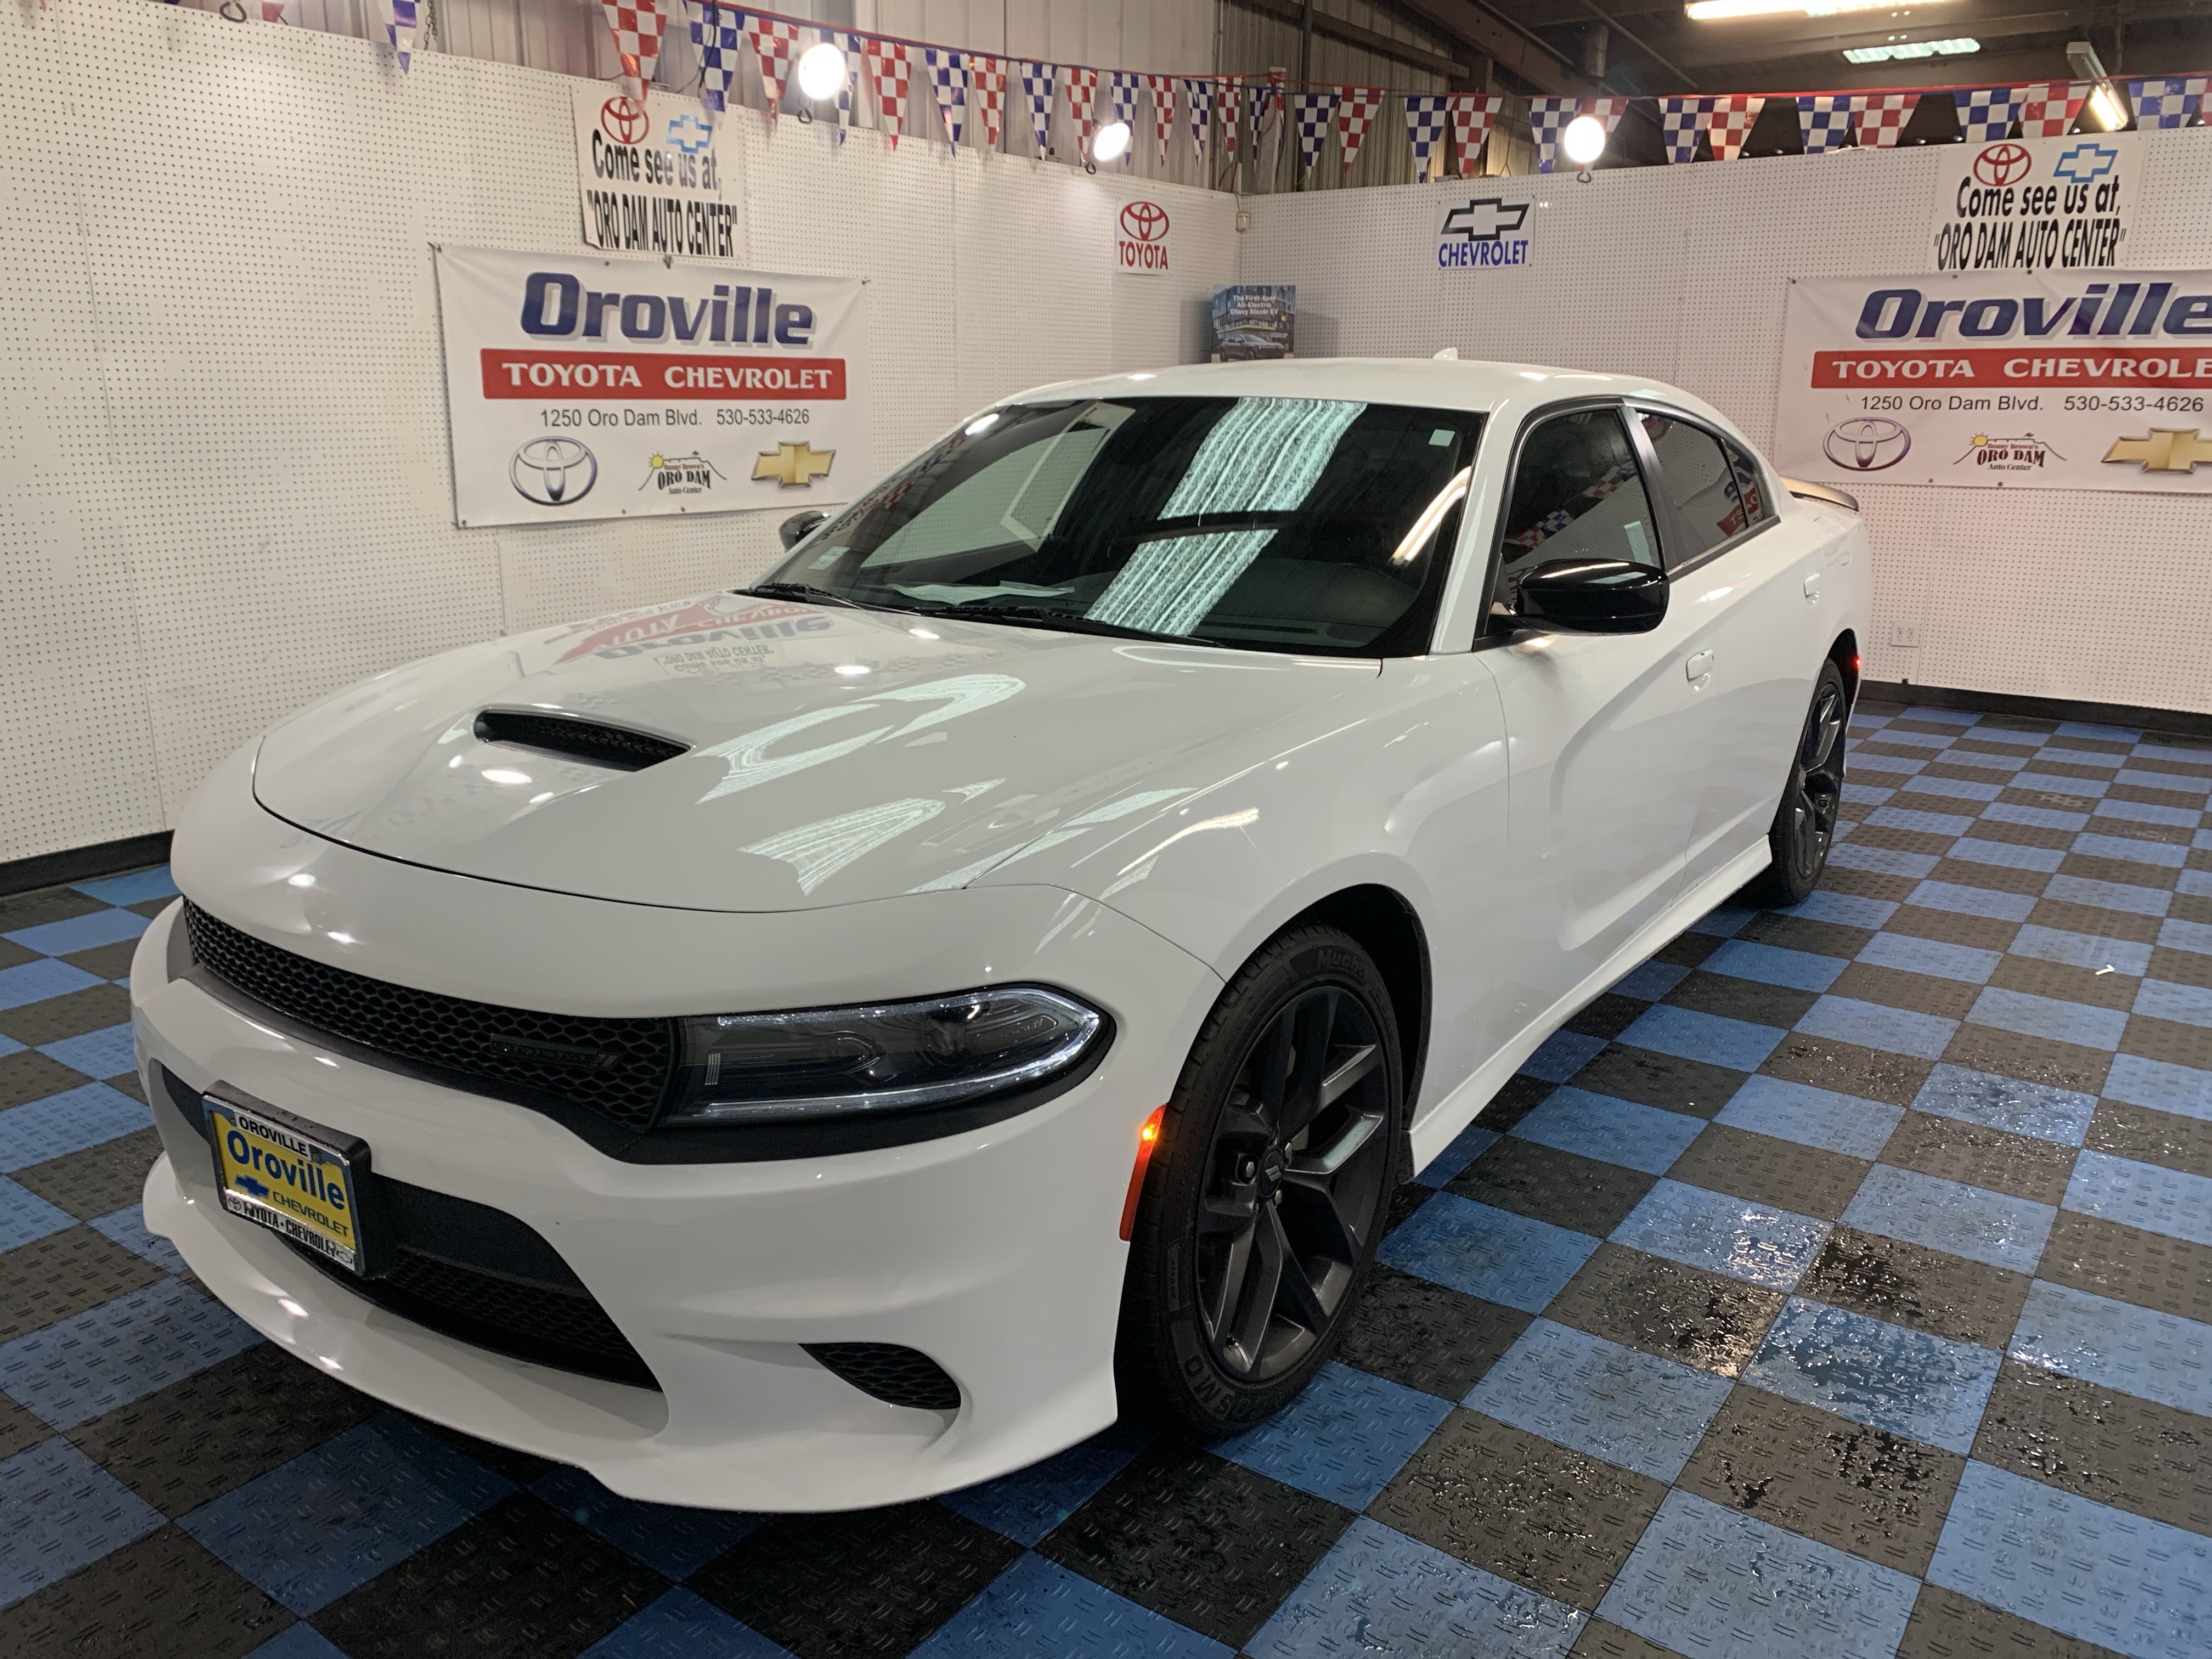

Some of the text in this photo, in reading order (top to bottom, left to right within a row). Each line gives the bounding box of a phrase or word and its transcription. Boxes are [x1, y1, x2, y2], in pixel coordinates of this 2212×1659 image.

[592, 128, 723, 202] Come see us at,
[1956, 174, 2121, 218] Come see us at,
[622, 193, 650, 251] DAM
[652, 196, 683, 255] AUTO
[1119, 240, 1169, 270] TOYOTA
[1438, 239, 1529, 268] CHEVROLET
[1974, 221, 2013, 269] DAM
[2012, 218, 2059, 269] AUTO
[520, 272, 814, 347] Oroville
[1229, 308, 1249, 316] Chevy
[1855, 282, 2212, 339] Oroville
[502, 362, 833, 390] TOYOTA CHEVROLET
[1831, 358, 2212, 379] TOYOTA CHEVROLE
[540, 408, 810, 427] 1250 Oro Dam Blvd. 530-533-4626
[1861, 395, 2204, 413] 1250 Oro Dam Blvd. 530-533-4626
[1977, 449, 2046, 468] ORO DAM
[658, 470, 712, 490] ORO DAM
[238, 1116, 309, 1158] OROVILLE
[227, 1130, 346, 1211] Oroville
[272, 1190, 349, 1238] CHEVROLET
